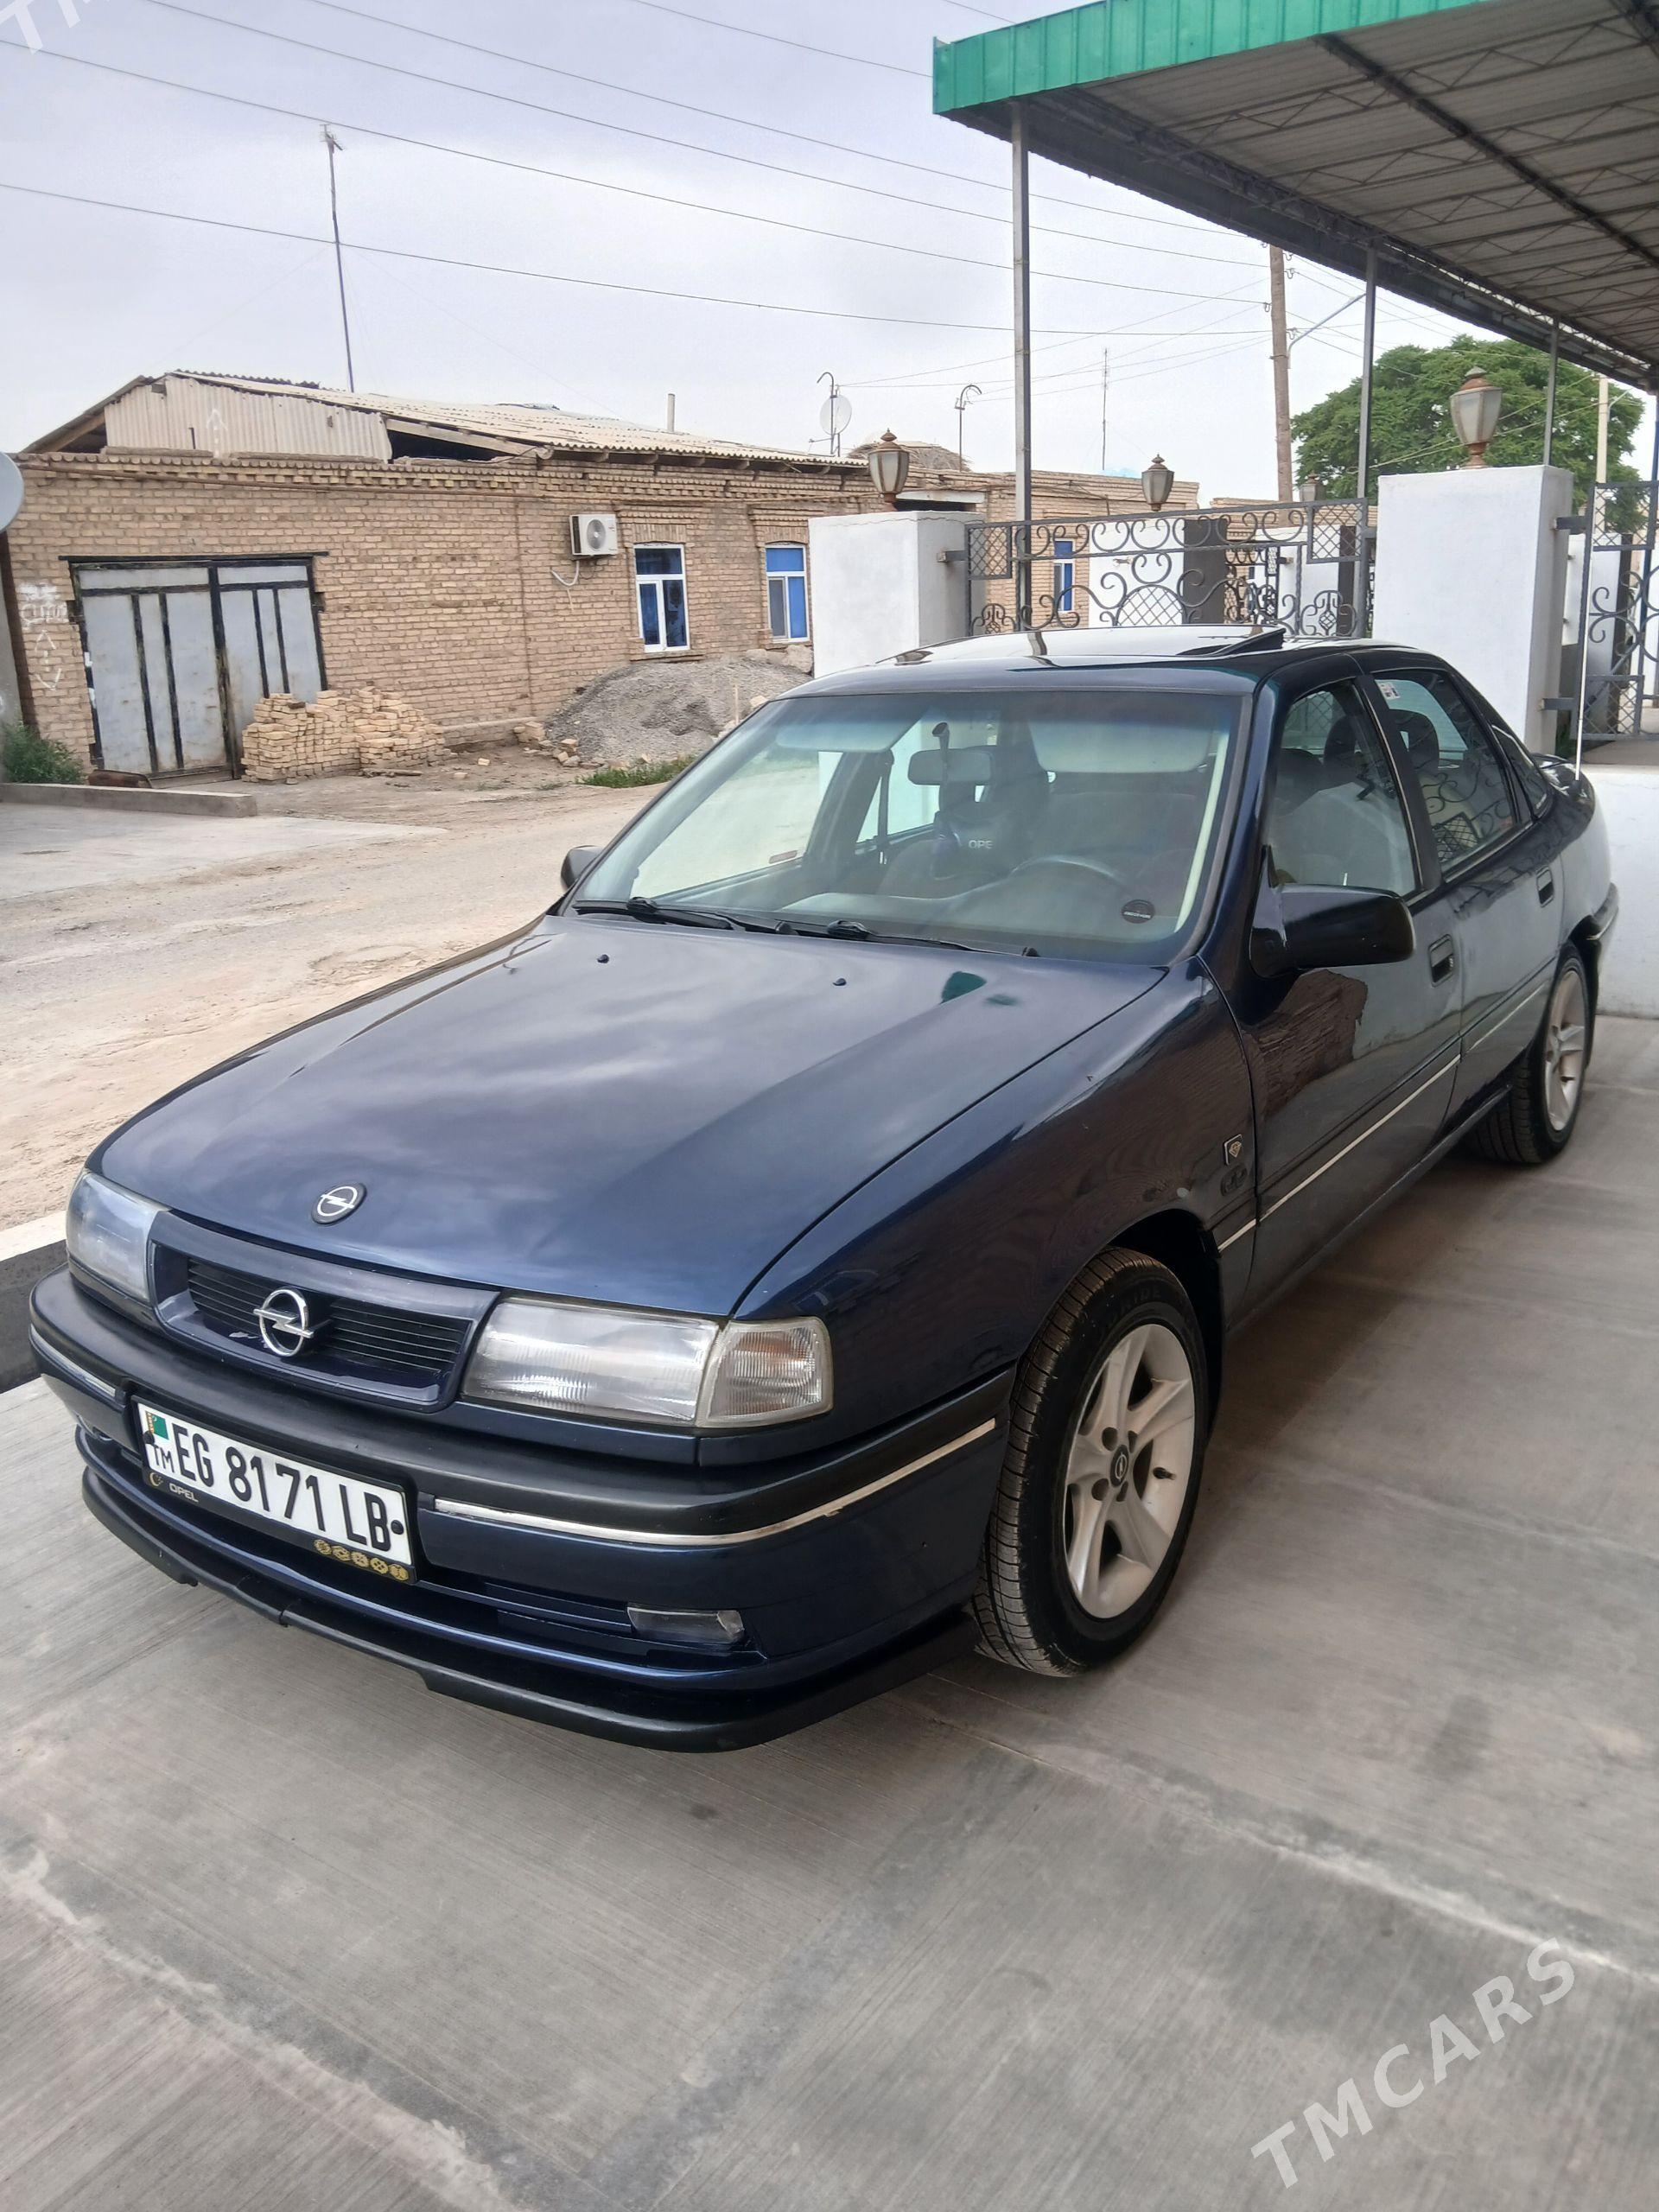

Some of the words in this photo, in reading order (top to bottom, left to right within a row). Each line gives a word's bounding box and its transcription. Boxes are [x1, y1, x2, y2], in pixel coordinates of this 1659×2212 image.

[152, 1443, 175, 1473] TM
[168, 1482, 200, 1503] OPEL
[172, 1423, 214, 1488] EG
[226, 1446, 326, 1532] 8171
[339, 1484, 391, 1552] LB
